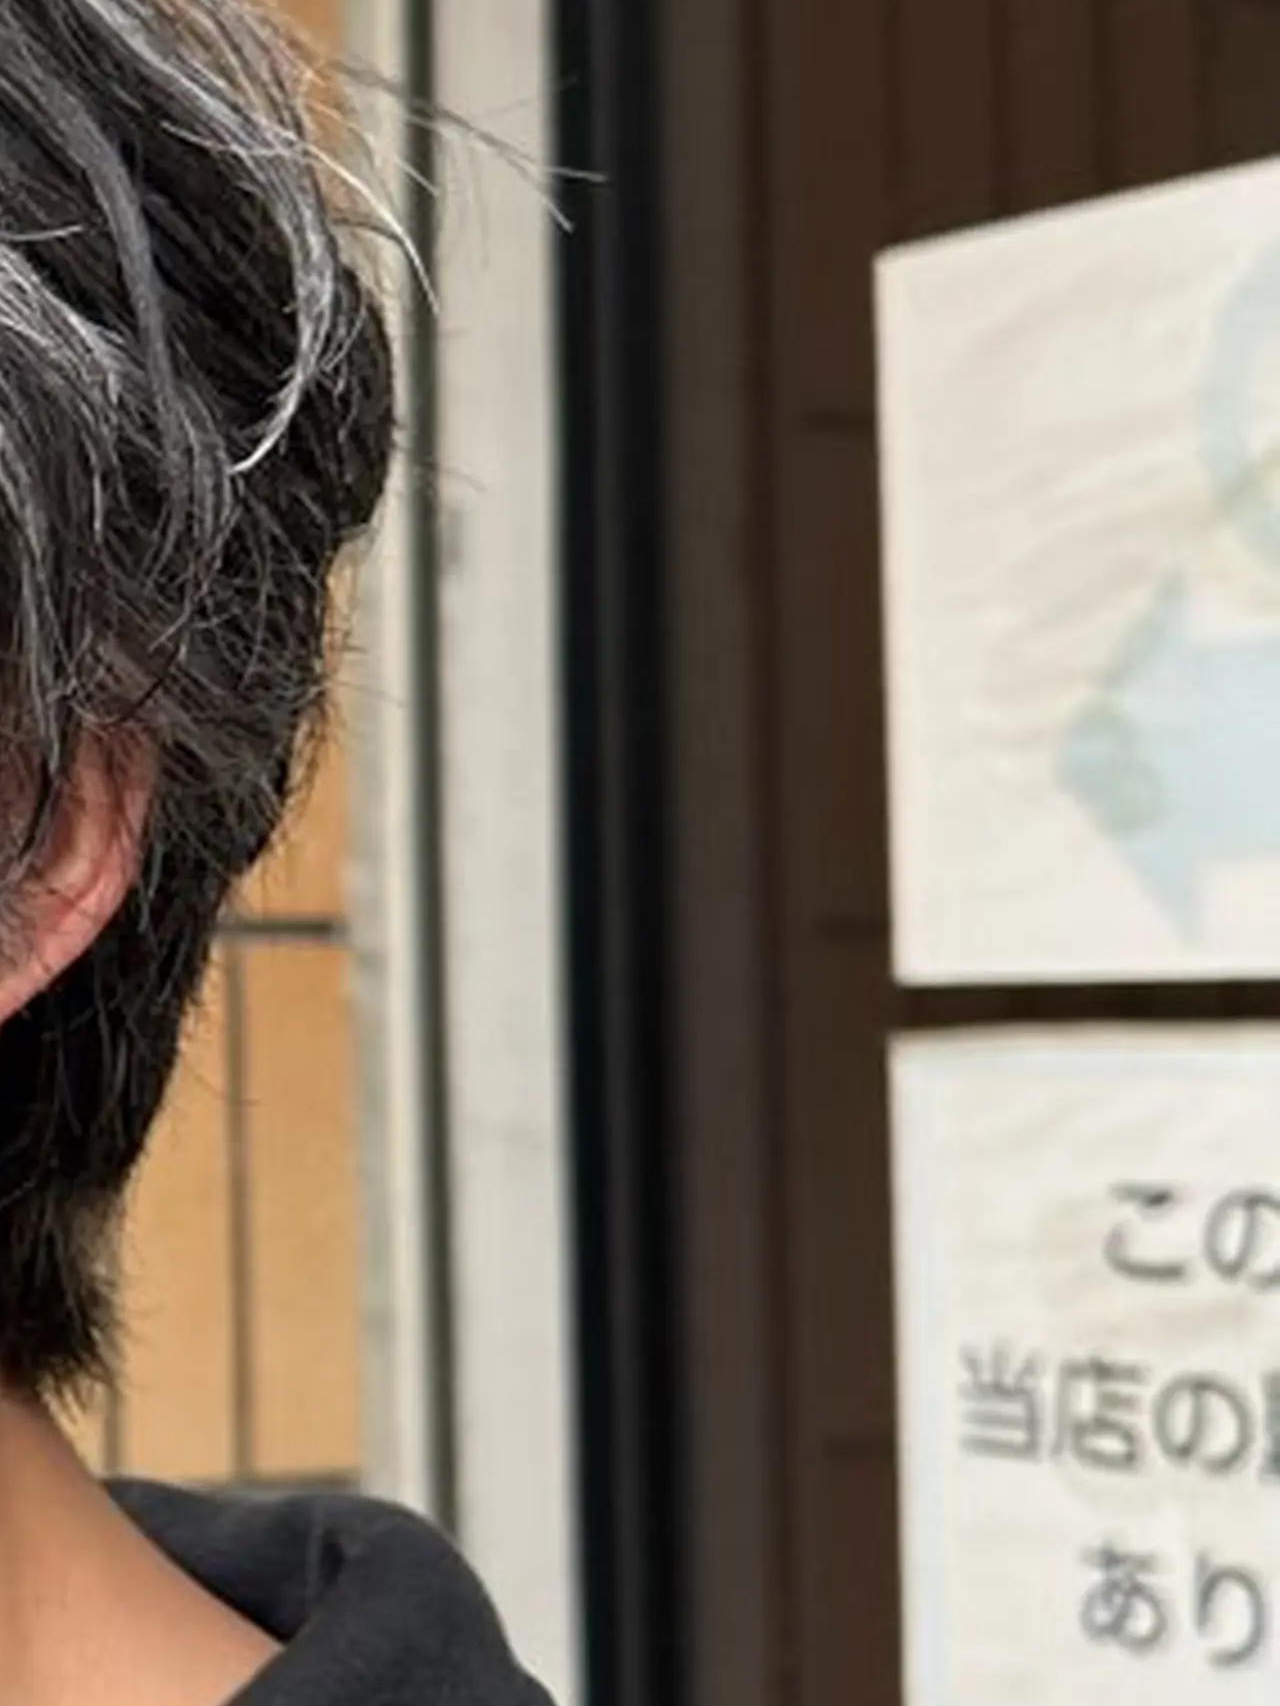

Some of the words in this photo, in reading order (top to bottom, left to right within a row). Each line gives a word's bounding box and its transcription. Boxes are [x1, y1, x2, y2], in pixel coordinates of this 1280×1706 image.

[1102, 1181, 1280, 1288] この
[958, 1340, 1280, 1480] 当店の
[1080, 1542, 1266, 1669] あり
